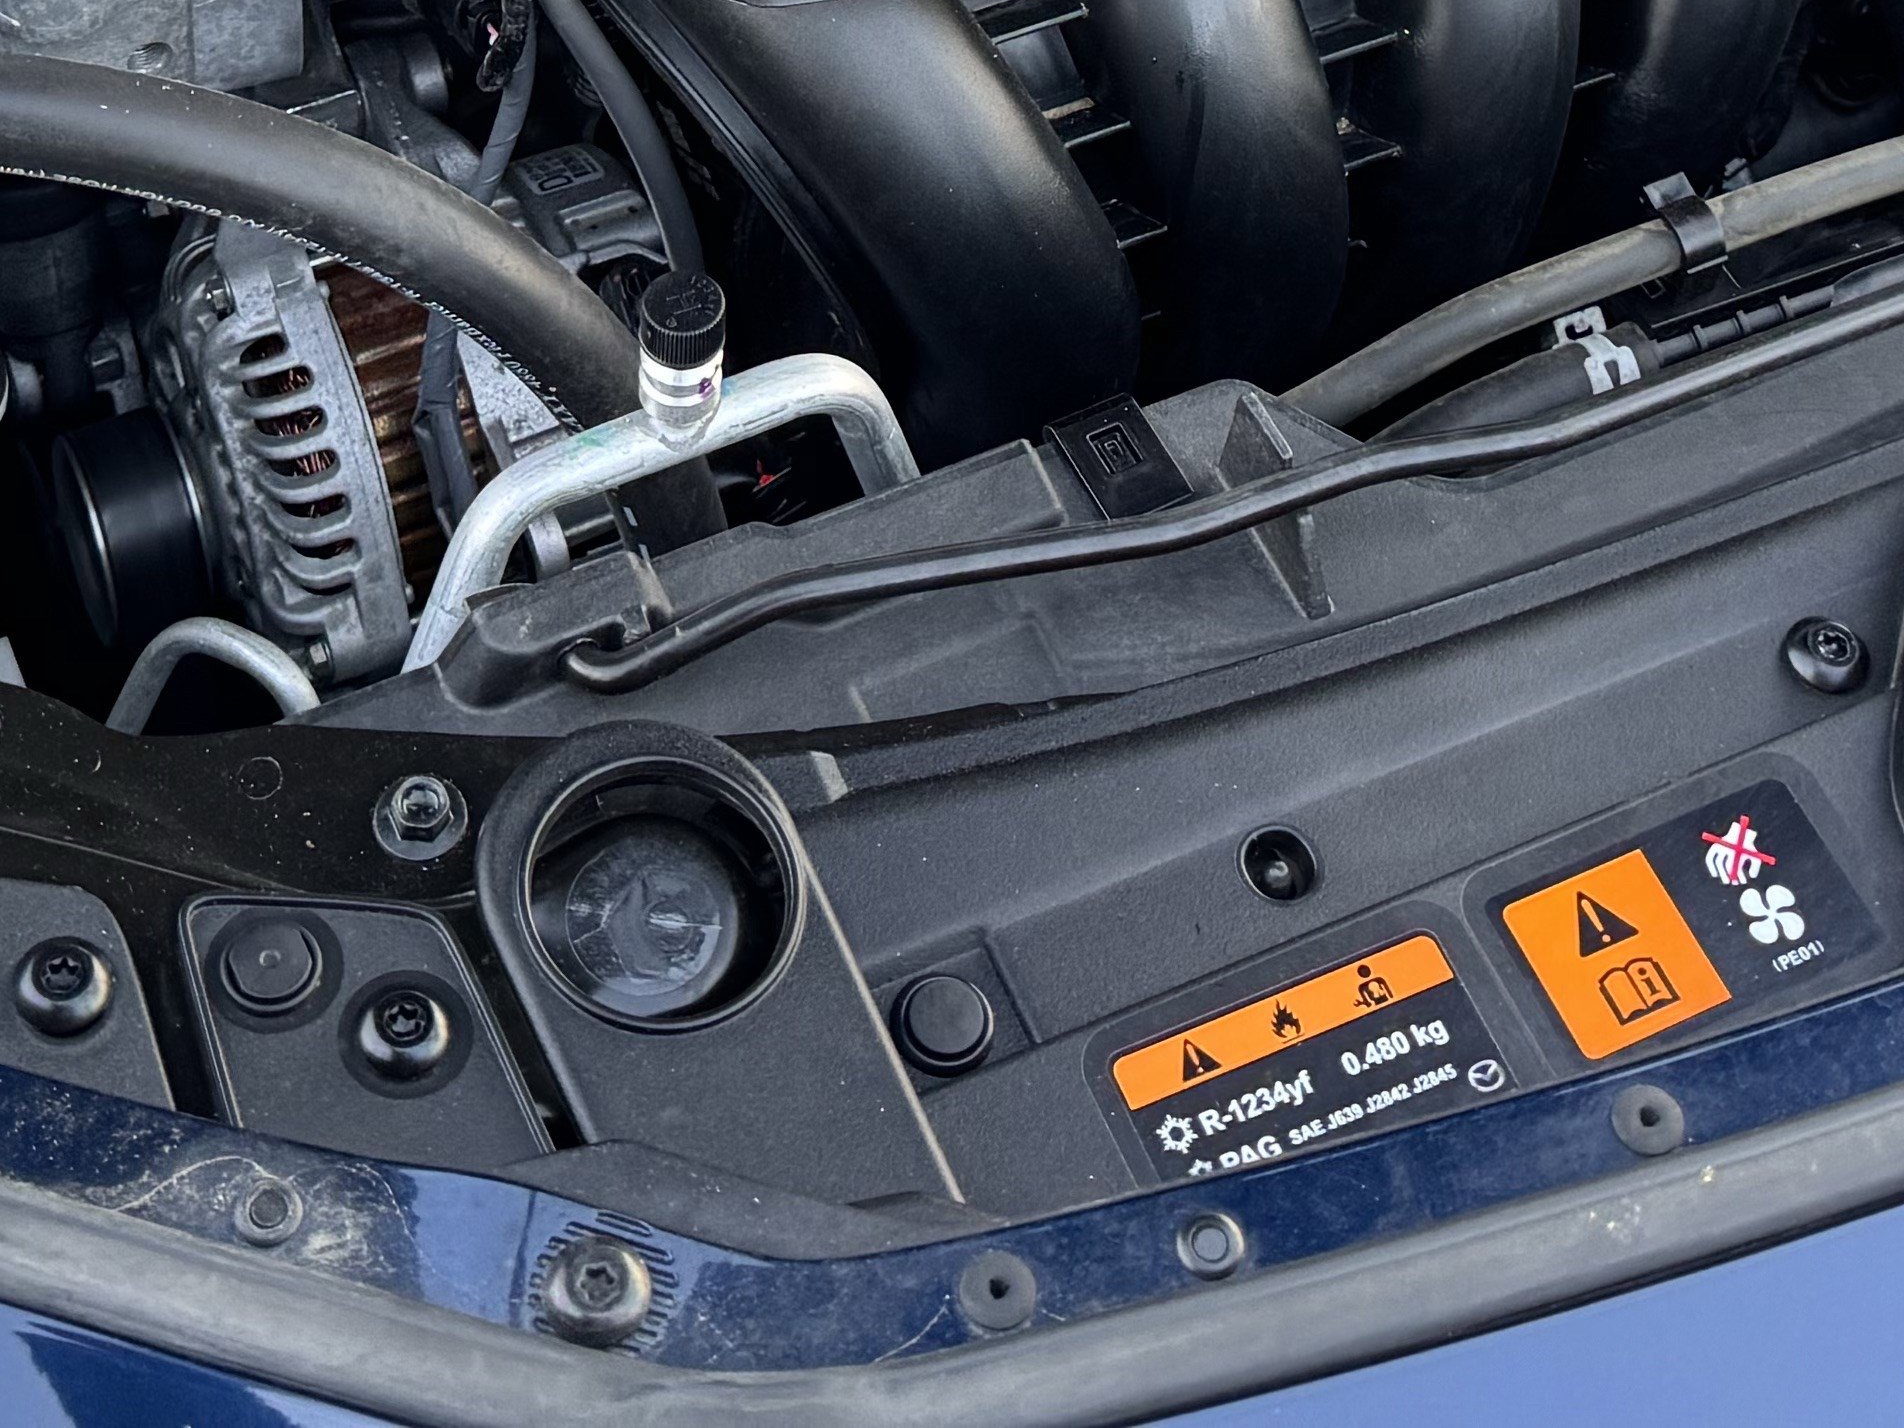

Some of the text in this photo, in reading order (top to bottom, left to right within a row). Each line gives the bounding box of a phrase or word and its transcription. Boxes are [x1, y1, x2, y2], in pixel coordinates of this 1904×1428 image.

[1772, 940, 1825, 973] (PE01)
[1198, 1019, 1450, 1136] R-1234yf 0.480 kg
[1219, 1135, 1283, 1171] PAG
[1288, 1118, 1325, 1145] SAE
